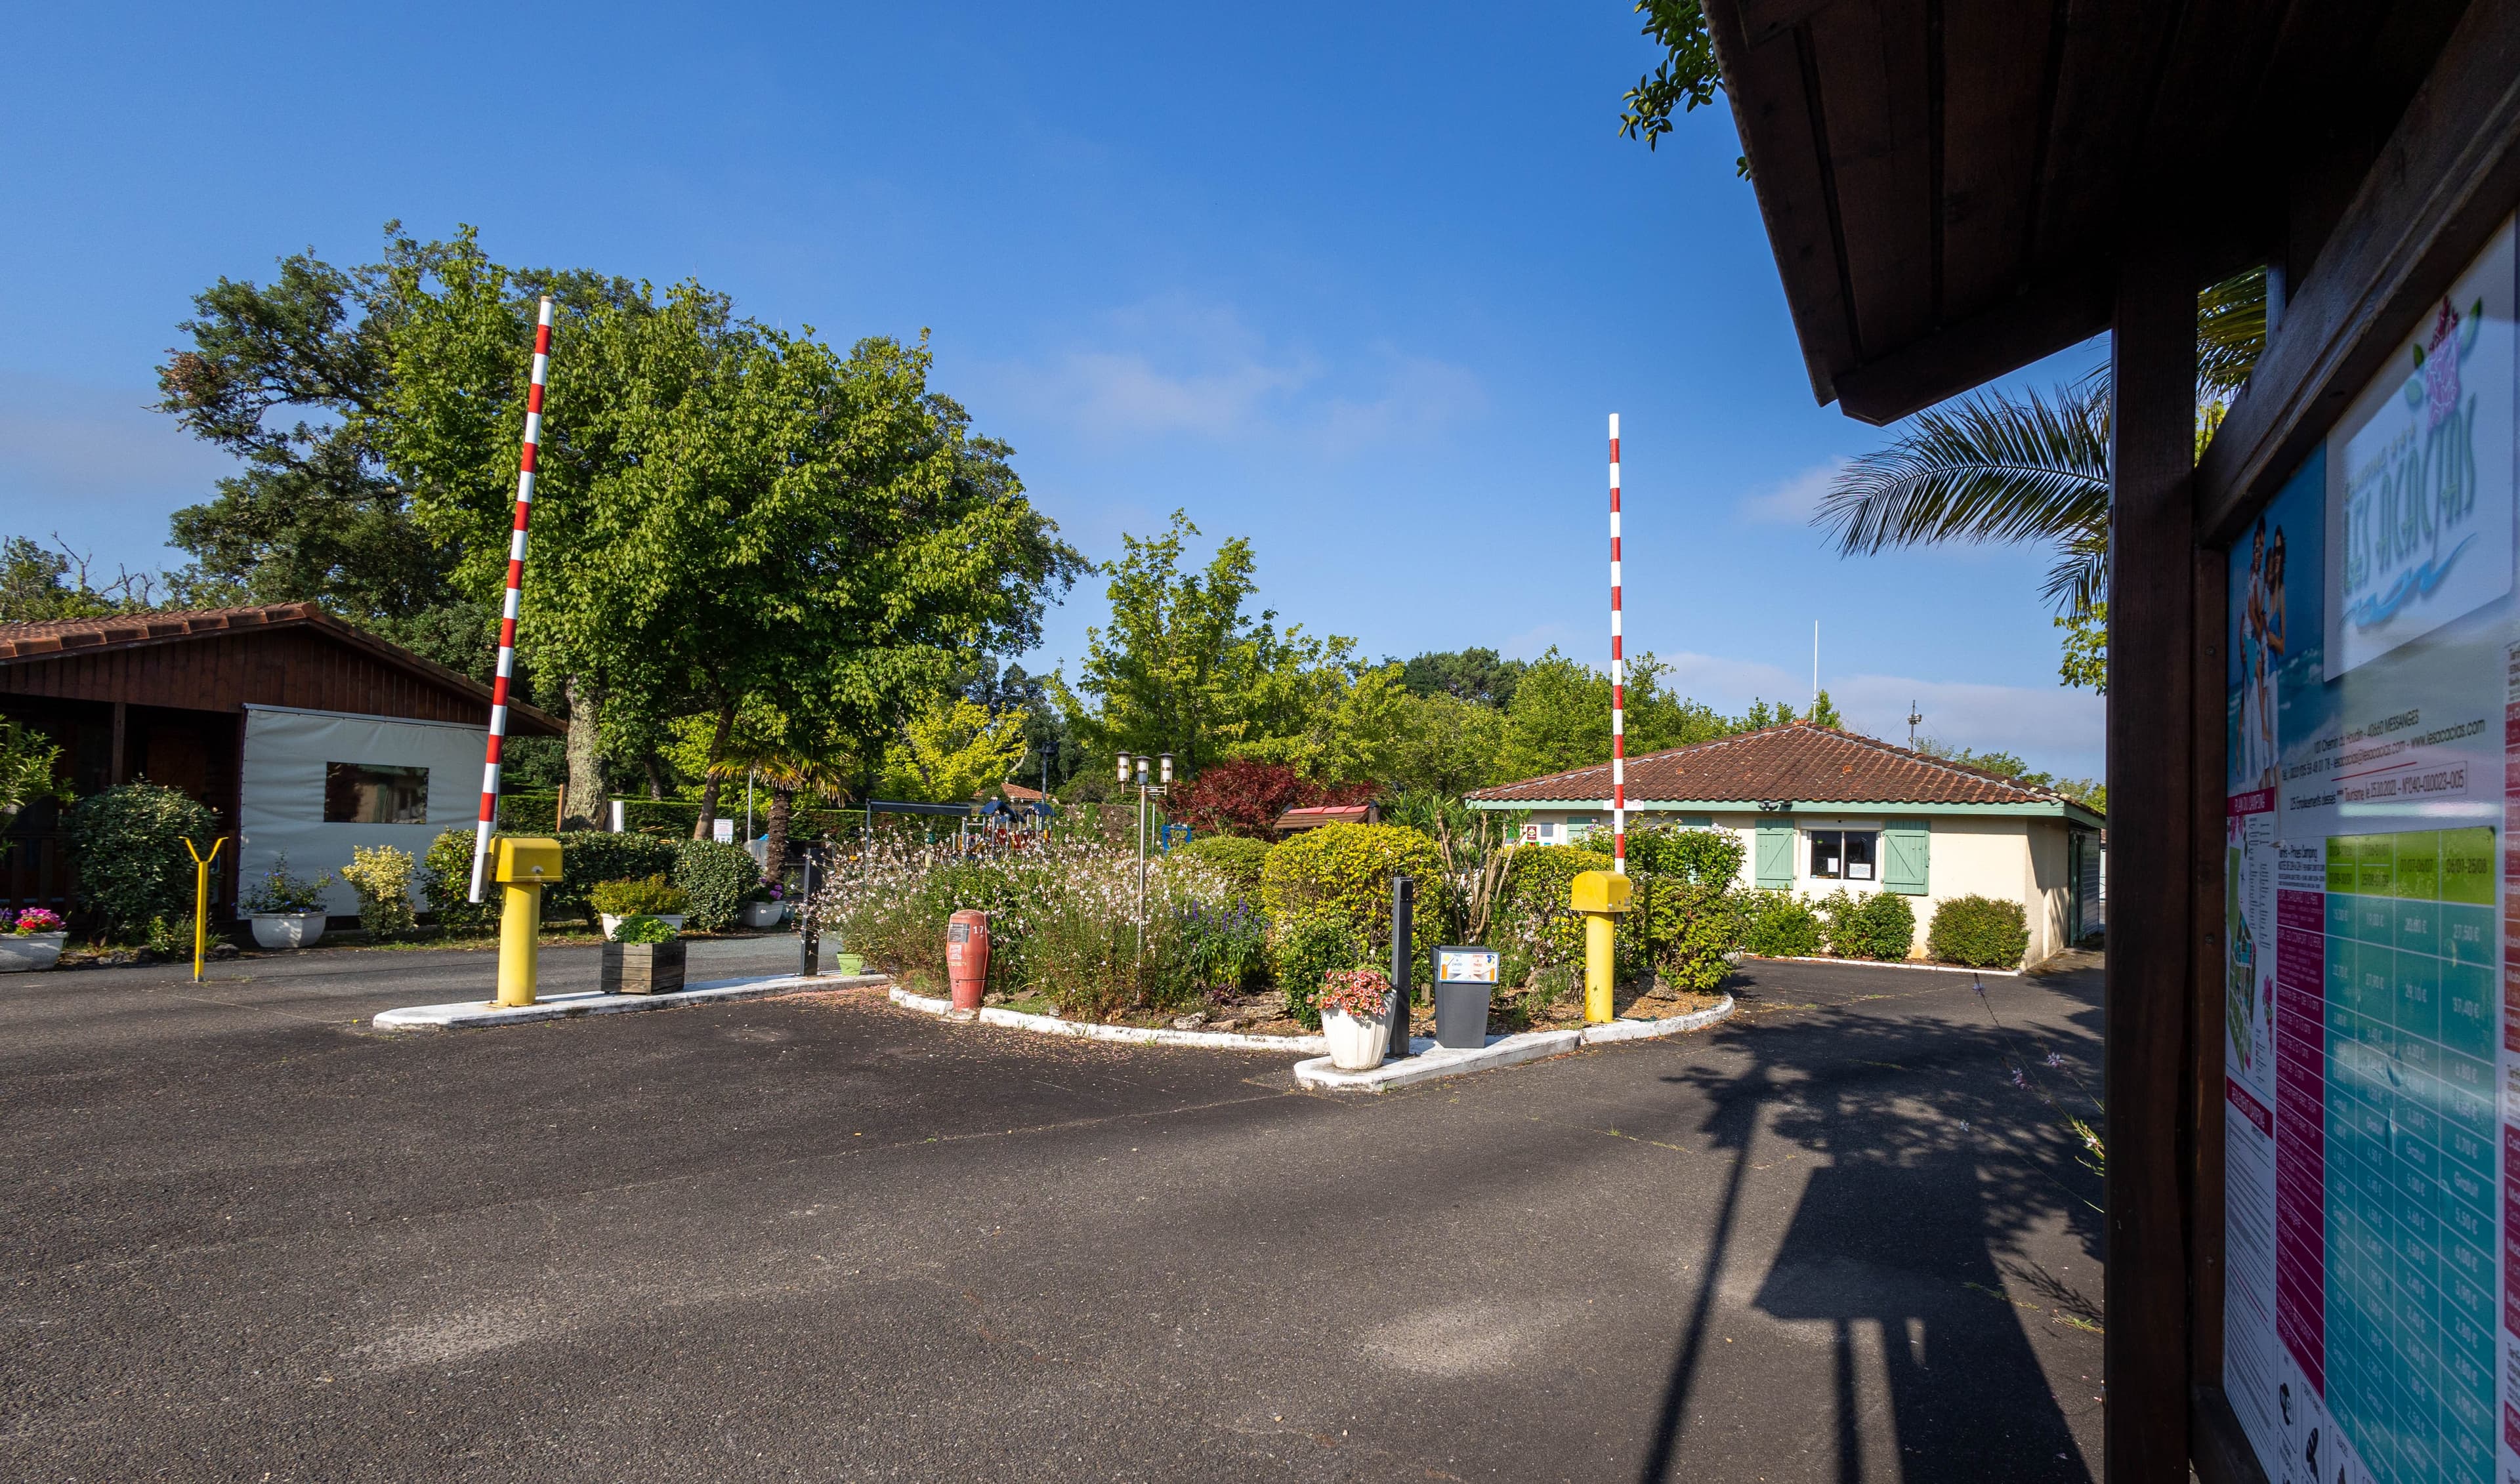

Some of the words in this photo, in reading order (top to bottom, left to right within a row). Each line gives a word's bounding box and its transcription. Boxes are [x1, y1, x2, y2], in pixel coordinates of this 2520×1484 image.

[2384, 709, 2420, 733] MESSANGES
[2410, 719, 2485, 749] www.lesacacias.com
[2345, 787, 2364, 802] Tourisme
[973, 925, 984, 934] 17
